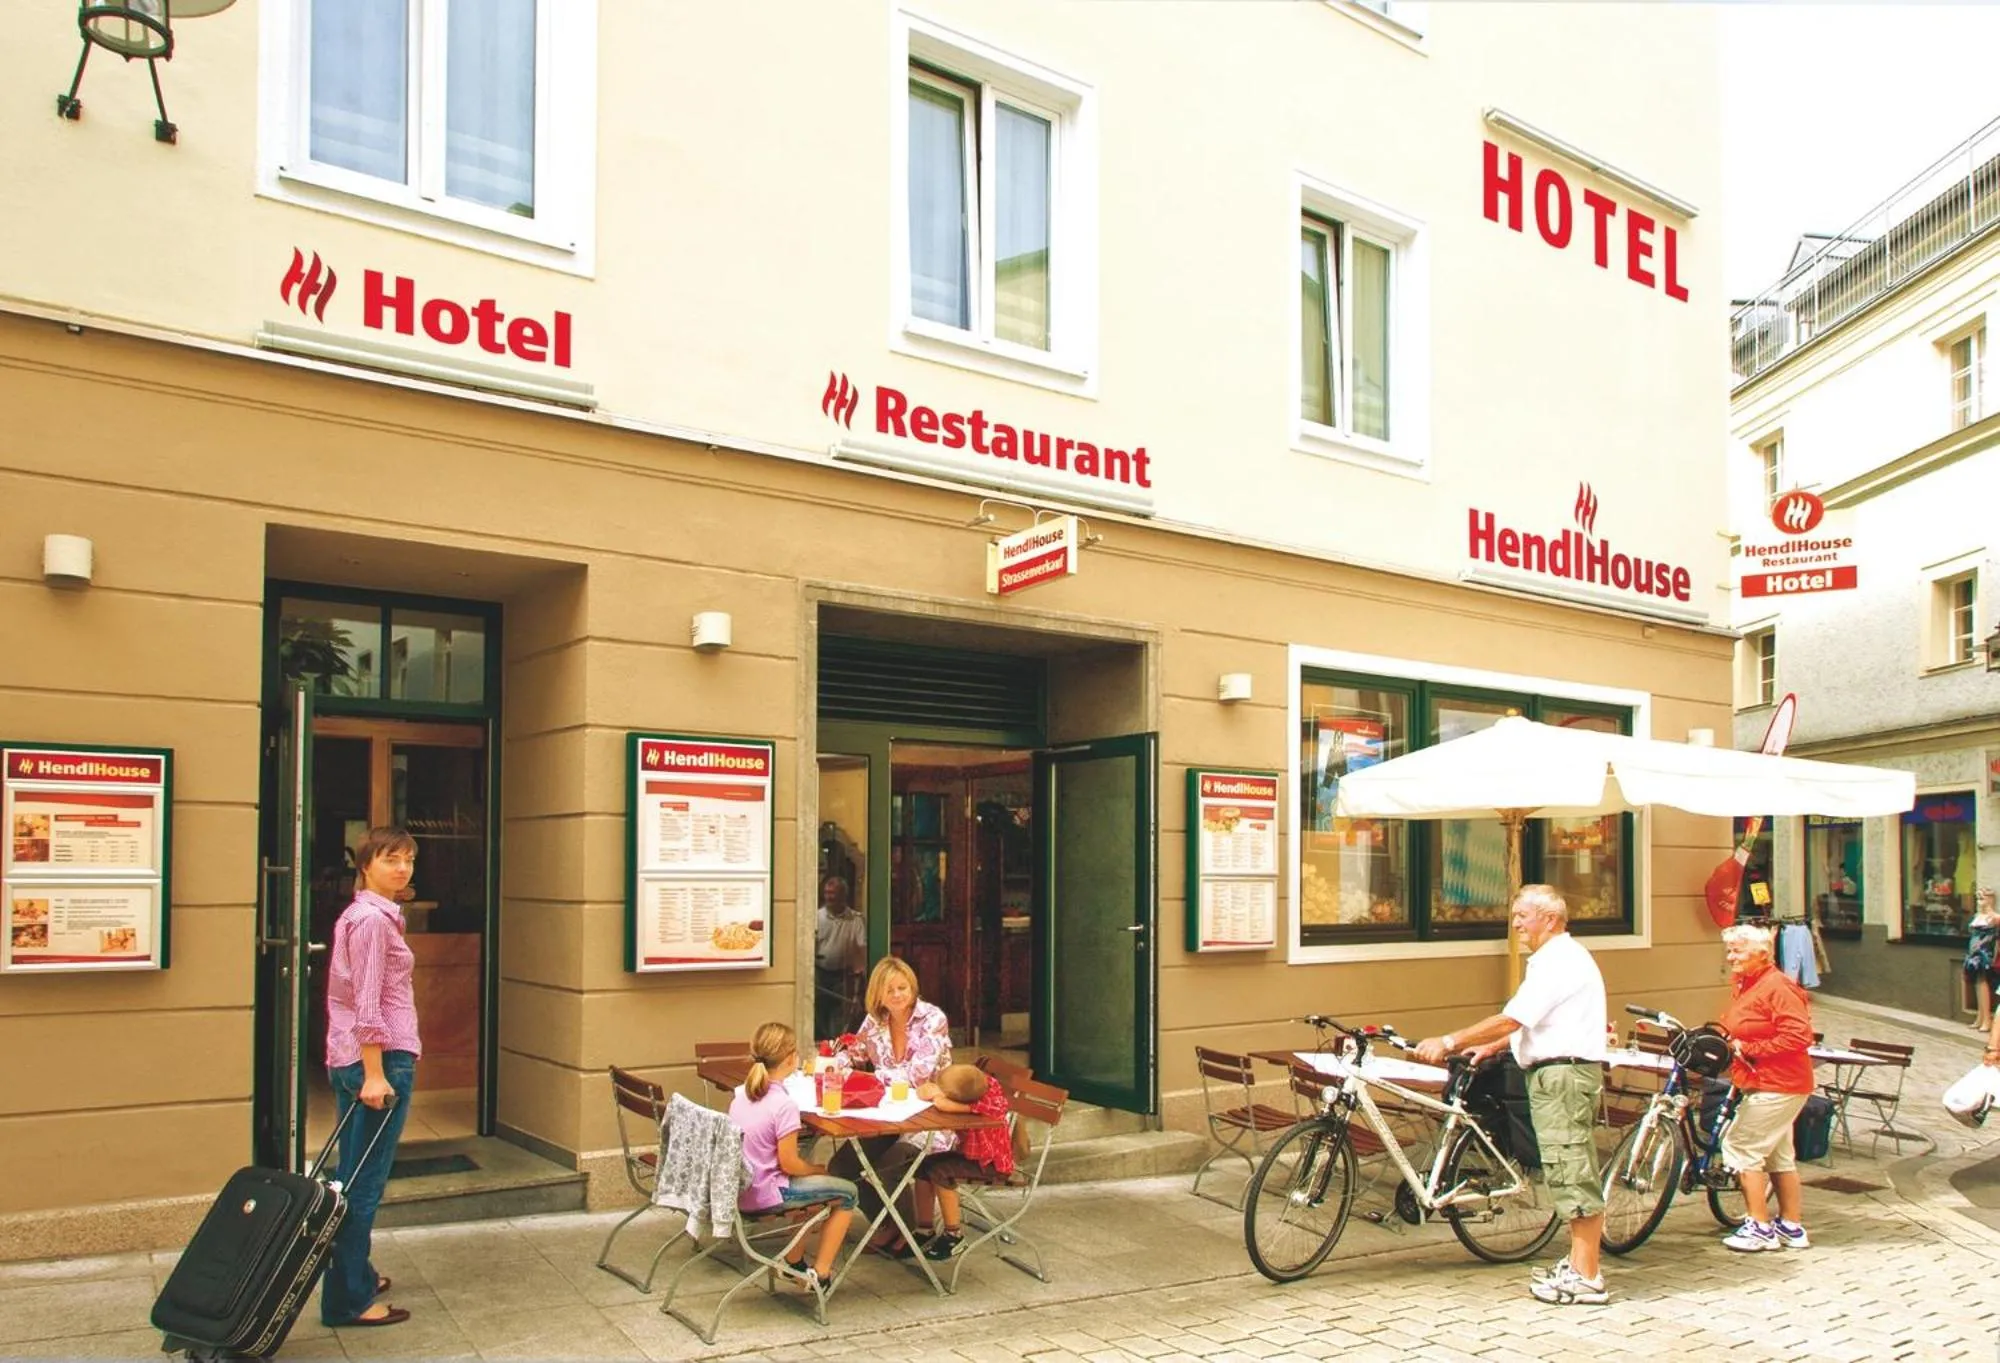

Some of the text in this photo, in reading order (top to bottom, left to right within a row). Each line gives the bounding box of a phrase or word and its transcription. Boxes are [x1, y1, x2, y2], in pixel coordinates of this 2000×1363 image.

[1483, 141, 1688, 302] HOTEL
[364, 269, 571, 368] Hotel
[876, 386, 1151, 488] Restaurant
[1004, 529, 1064, 560] HendlHouse
[1469, 508, 1691, 602] HendlHouse
[1745, 537, 1852, 557] HendlHouse
[1762, 552, 1838, 567] Restaurant
[1766, 569, 1833, 593] Hotel
[38, 760, 151, 778] HendlHouse
[664, 750, 765, 770] HendlHouse
[1213, 781, 1274, 796] HendlHouse
